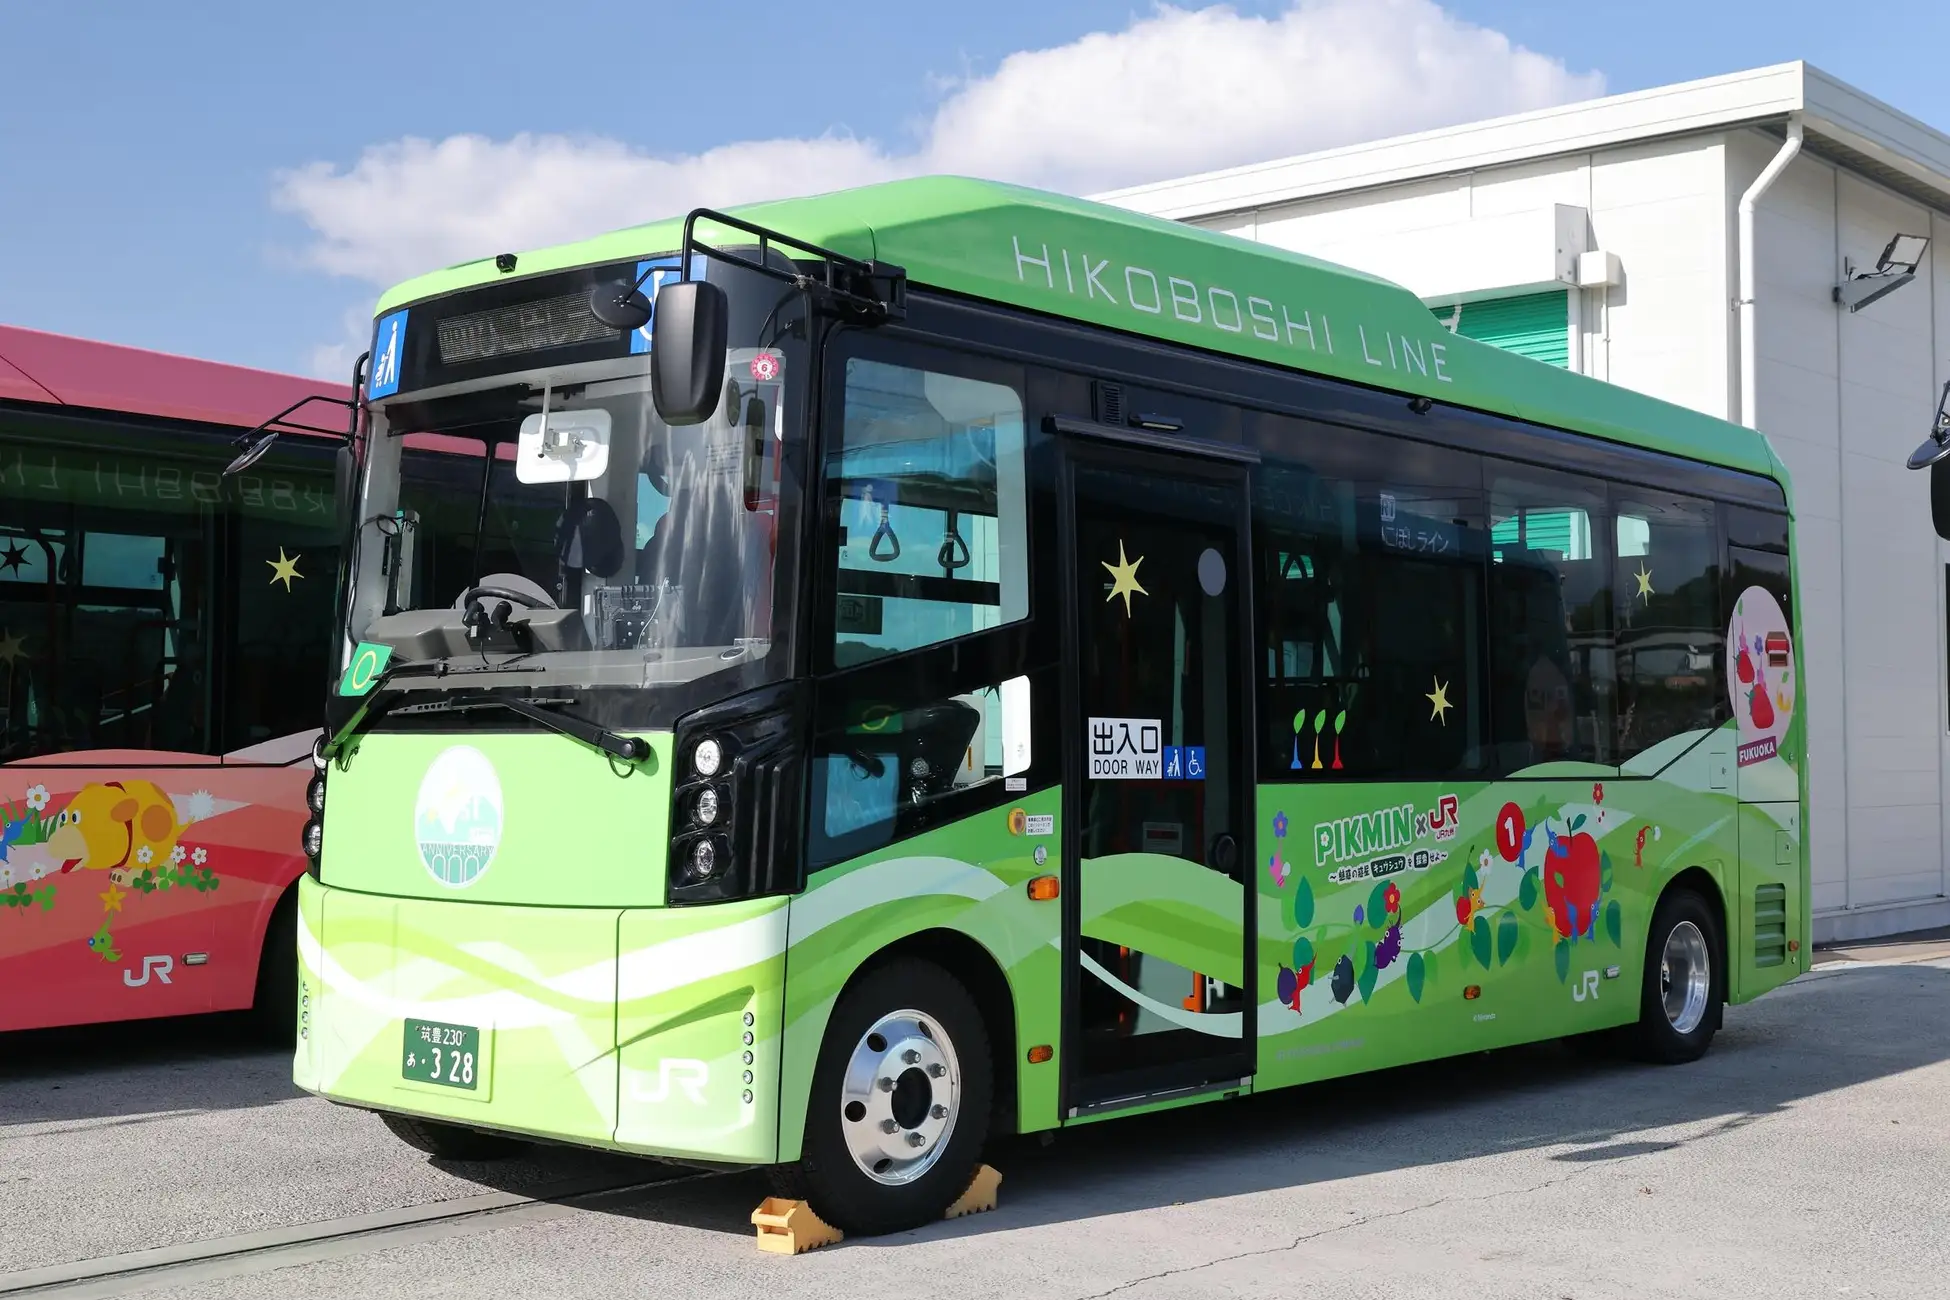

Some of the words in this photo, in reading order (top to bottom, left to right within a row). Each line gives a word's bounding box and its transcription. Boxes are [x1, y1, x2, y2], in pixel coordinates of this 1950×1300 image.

[1012, 236, 1334, 354] HIKOBOSHI
[1359, 324, 1452, 383] LINE
[1093, 721, 1159, 755] 出入口
[1739, 742, 1774, 762] FUKUOKA
[1094, 759, 1128, 775] DOOR
[1135, 760, 1159, 775] WAY
[1315, 804, 1413, 866] PIKMIN
[1429, 795, 1459, 830] JR
[1504, 816, 1516, 847] 1
[420, 843, 495, 858] ANNIVERSARY
[123, 954, 174, 987] JR
[1573, 969, 1599, 1002] JR
[629, 1057, 709, 1106] JR
